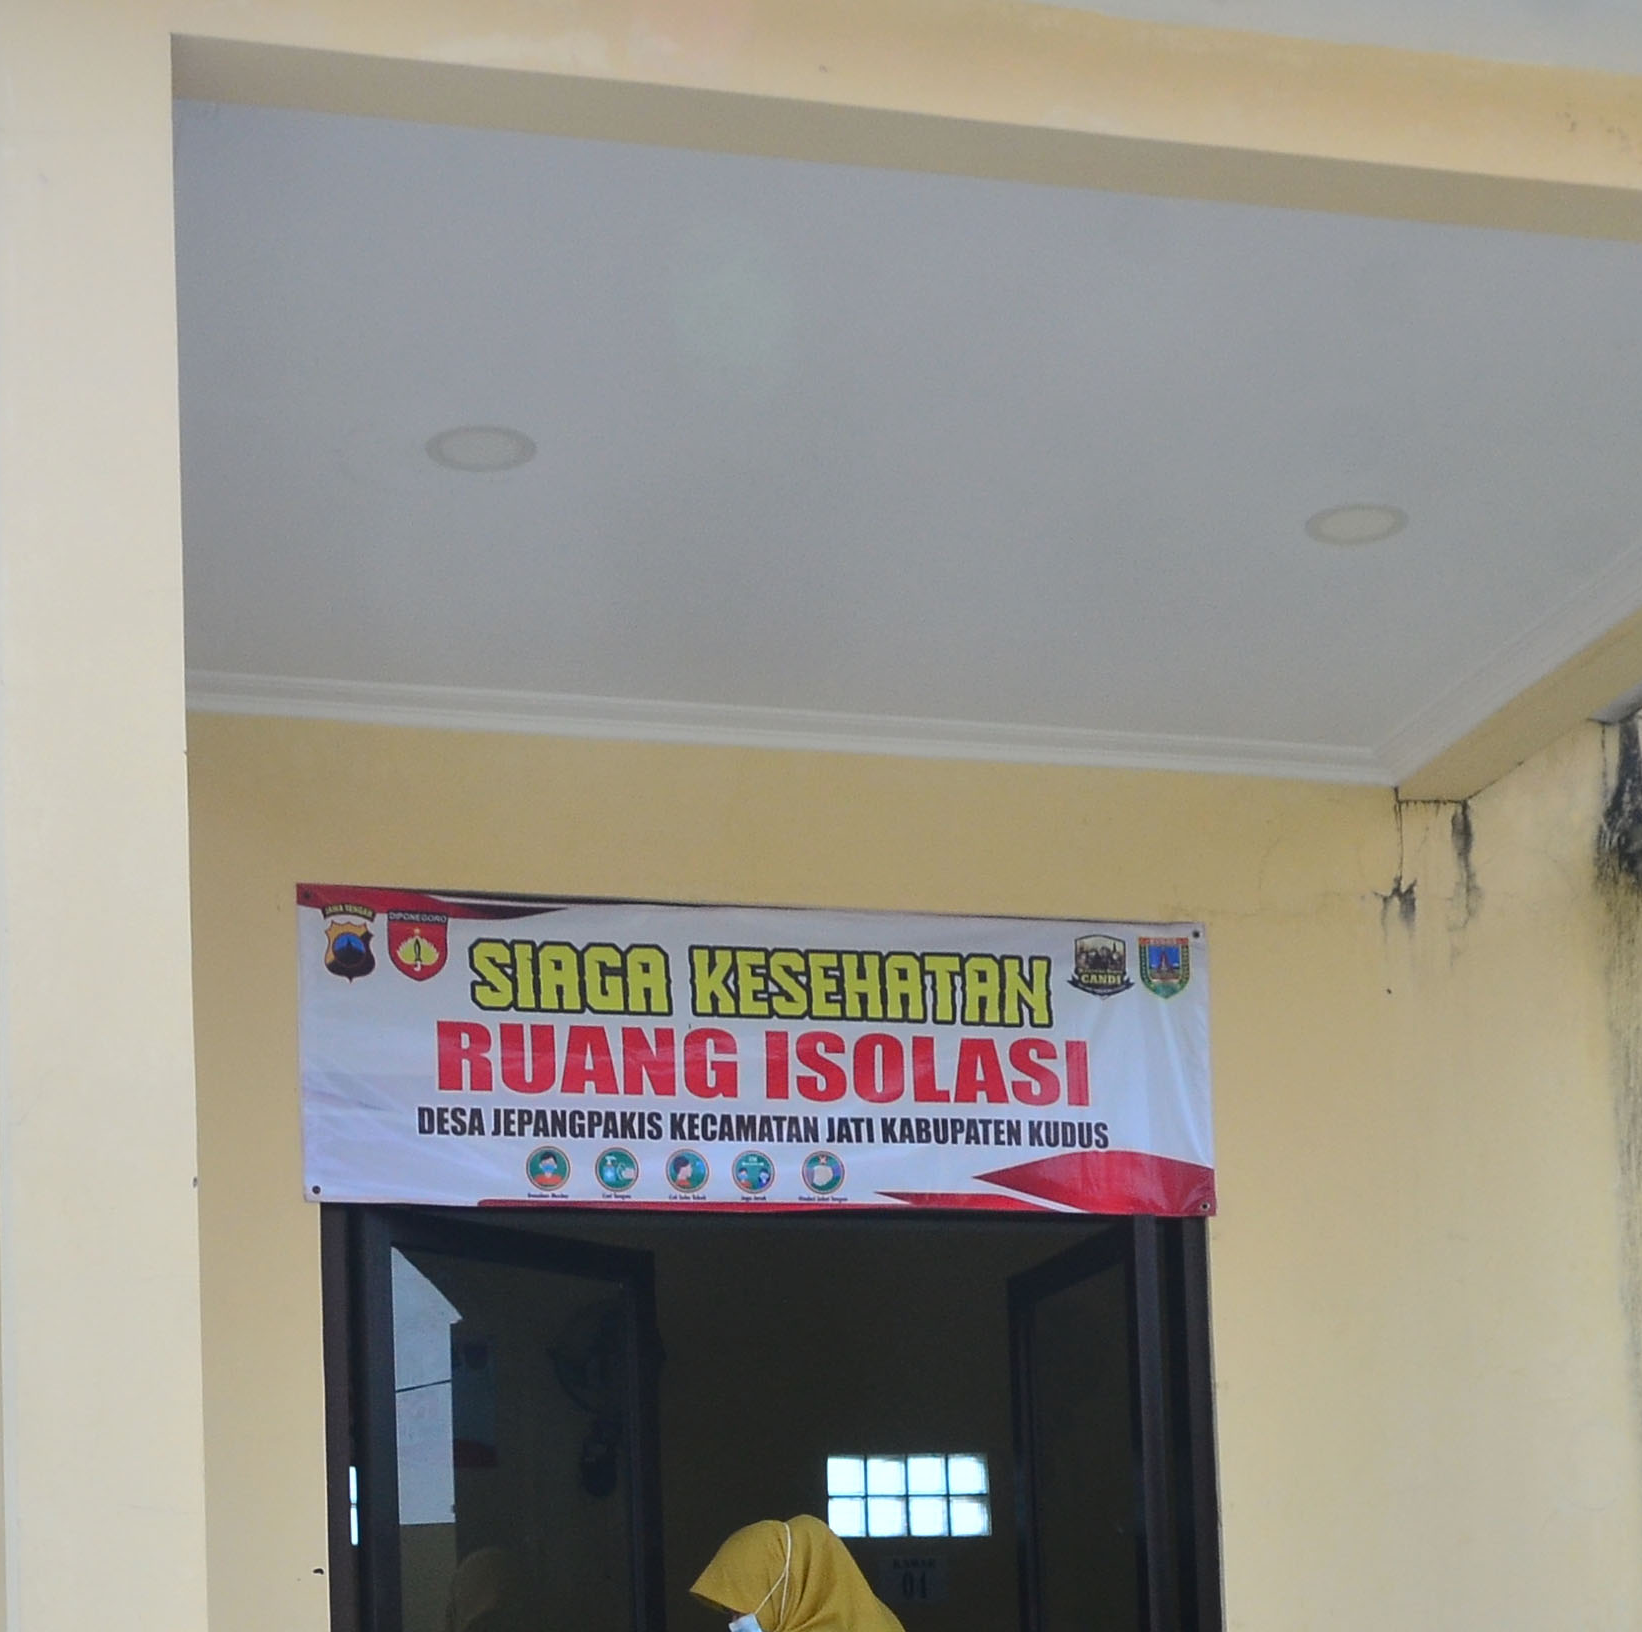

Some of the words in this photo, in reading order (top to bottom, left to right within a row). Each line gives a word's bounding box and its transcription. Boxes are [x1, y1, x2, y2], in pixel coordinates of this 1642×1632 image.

[389, 912, 447, 923] DIPONEGORO
[469, 938, 673, 1016] SIAGA
[688, 945, 1054, 1028] KESEHATAN
[1081, 974, 1122, 984] CANDI
[436, 1020, 738, 1099] RUANG
[765, 1030, 1090, 1107] ISOLASI
[417, 1106, 486, 1136] DESA
[490, 1108, 663, 1140] JEPANGPAKIS
[669, 1112, 819, 1143] KECAMATAN
[826, 1116, 875, 1144] JATI
[880, 1117, 1022, 1146] KABUPATEN
[1028, 1120, 1110, 1149] KUDUS
